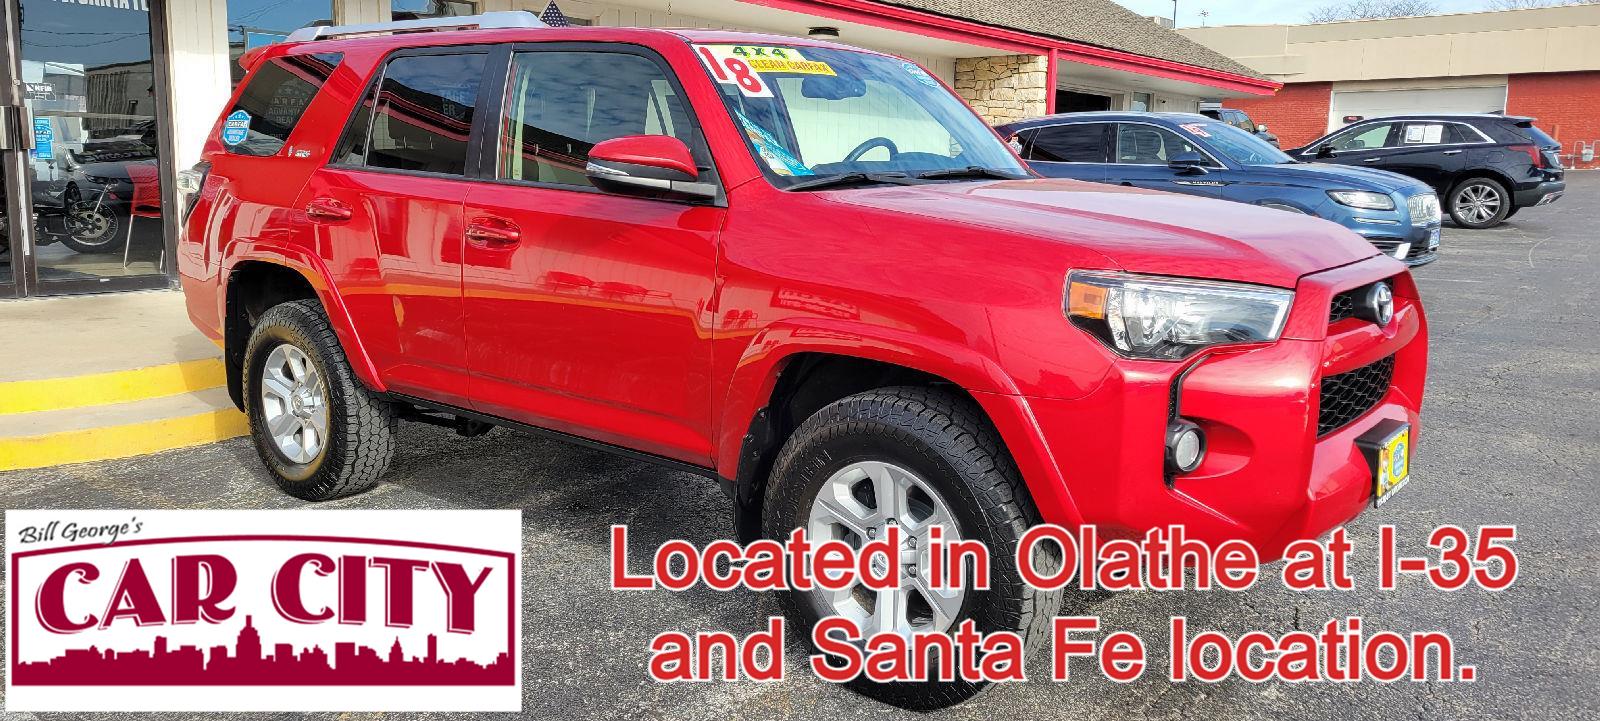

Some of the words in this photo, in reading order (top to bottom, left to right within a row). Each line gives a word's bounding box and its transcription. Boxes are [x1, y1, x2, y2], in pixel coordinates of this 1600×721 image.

[699, 46, 762, 93] 18
[748, 58, 788, 71] CLEAN
[787, 60, 831, 73] CARFAX
